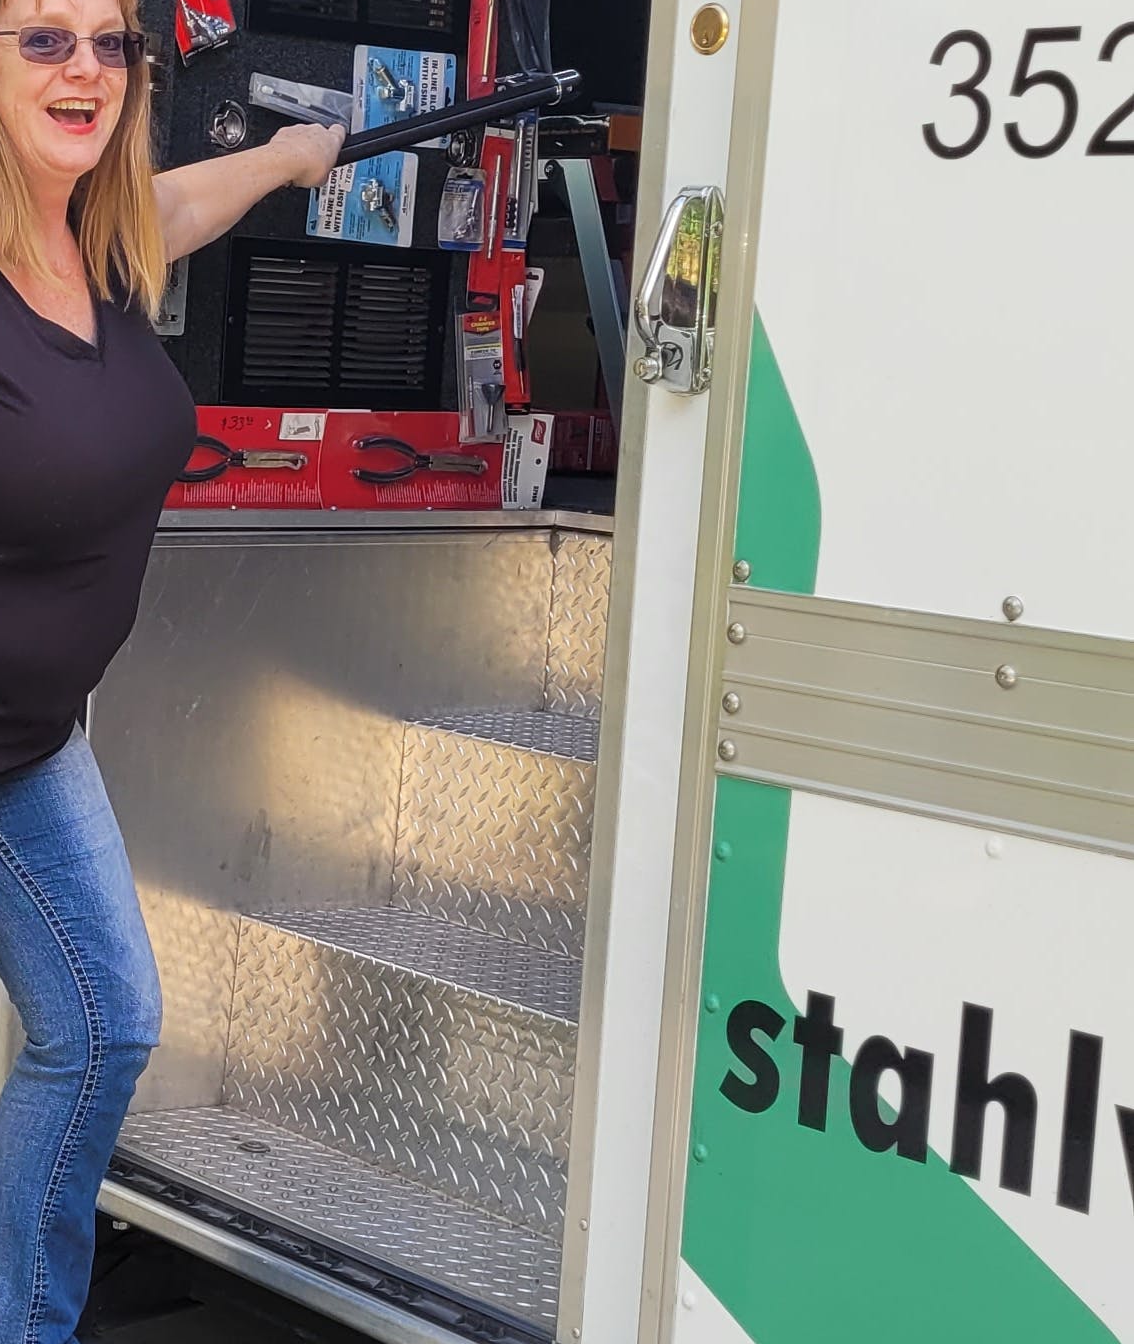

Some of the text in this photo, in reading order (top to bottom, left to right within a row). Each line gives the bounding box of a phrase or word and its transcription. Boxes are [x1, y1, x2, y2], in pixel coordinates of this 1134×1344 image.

[421, 57, 430, 81] WITH
[922, 21, 1134, 159] 352
[333, 209, 343, 233] WITH
[719, 989, 1134, 1216] stahl
